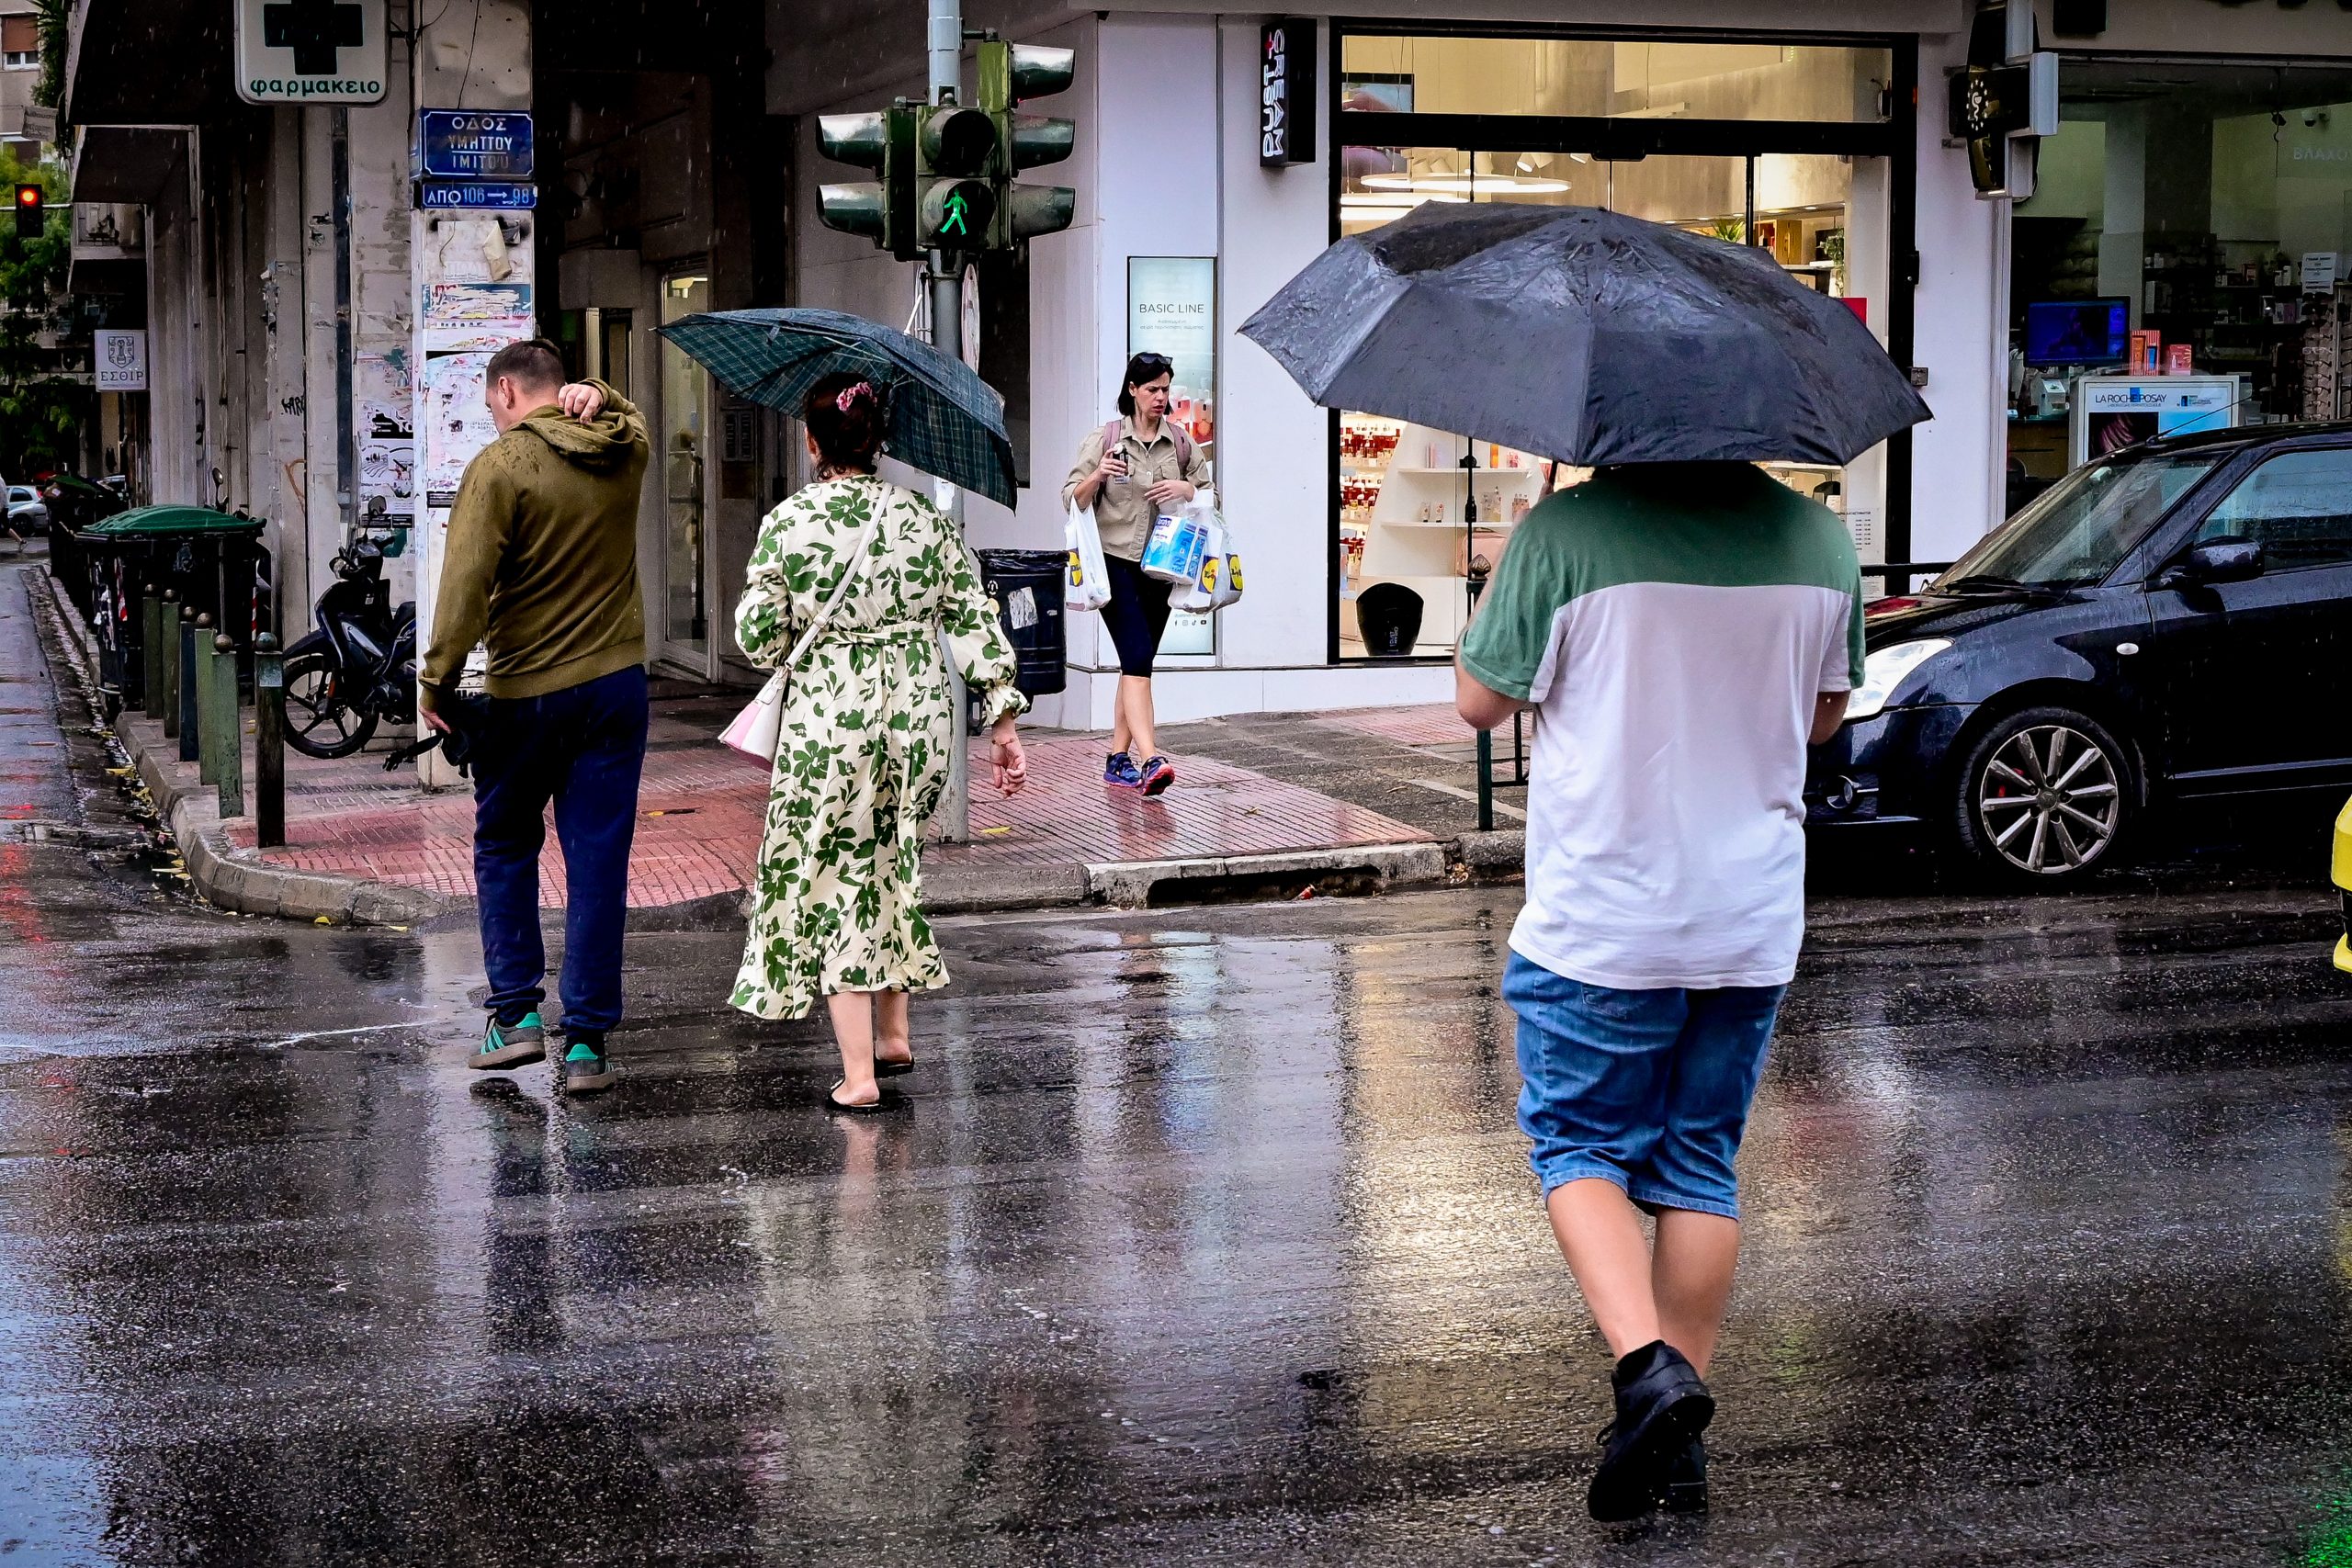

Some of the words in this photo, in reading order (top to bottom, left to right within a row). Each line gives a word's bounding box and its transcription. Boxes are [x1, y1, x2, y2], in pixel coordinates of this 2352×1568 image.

[249, 79, 380, 96] φαρμακειο
[1273, 28, 1285, 156] CREAM
[451, 117, 507, 130] ΟΔΟΣ
[447, 135, 513, 151] ΥΜΗΤΤΟΥ
[452, 154, 509, 169] IMITOU
[427, 190, 461, 203] ΑΠΟ
[463, 186, 485, 203] 106
[513, 187, 529, 204] 98
[1139, 303, 1175, 313] BASIC
[1178, 303, 1204, 313] LINE
[100, 371, 144, 381] ΕΣΘΙΡ
[2095, 394, 2107, 403] LA
[2107, 394, 2139, 403] ROCHE
[2139, 394, 2167, 403] POSAY
